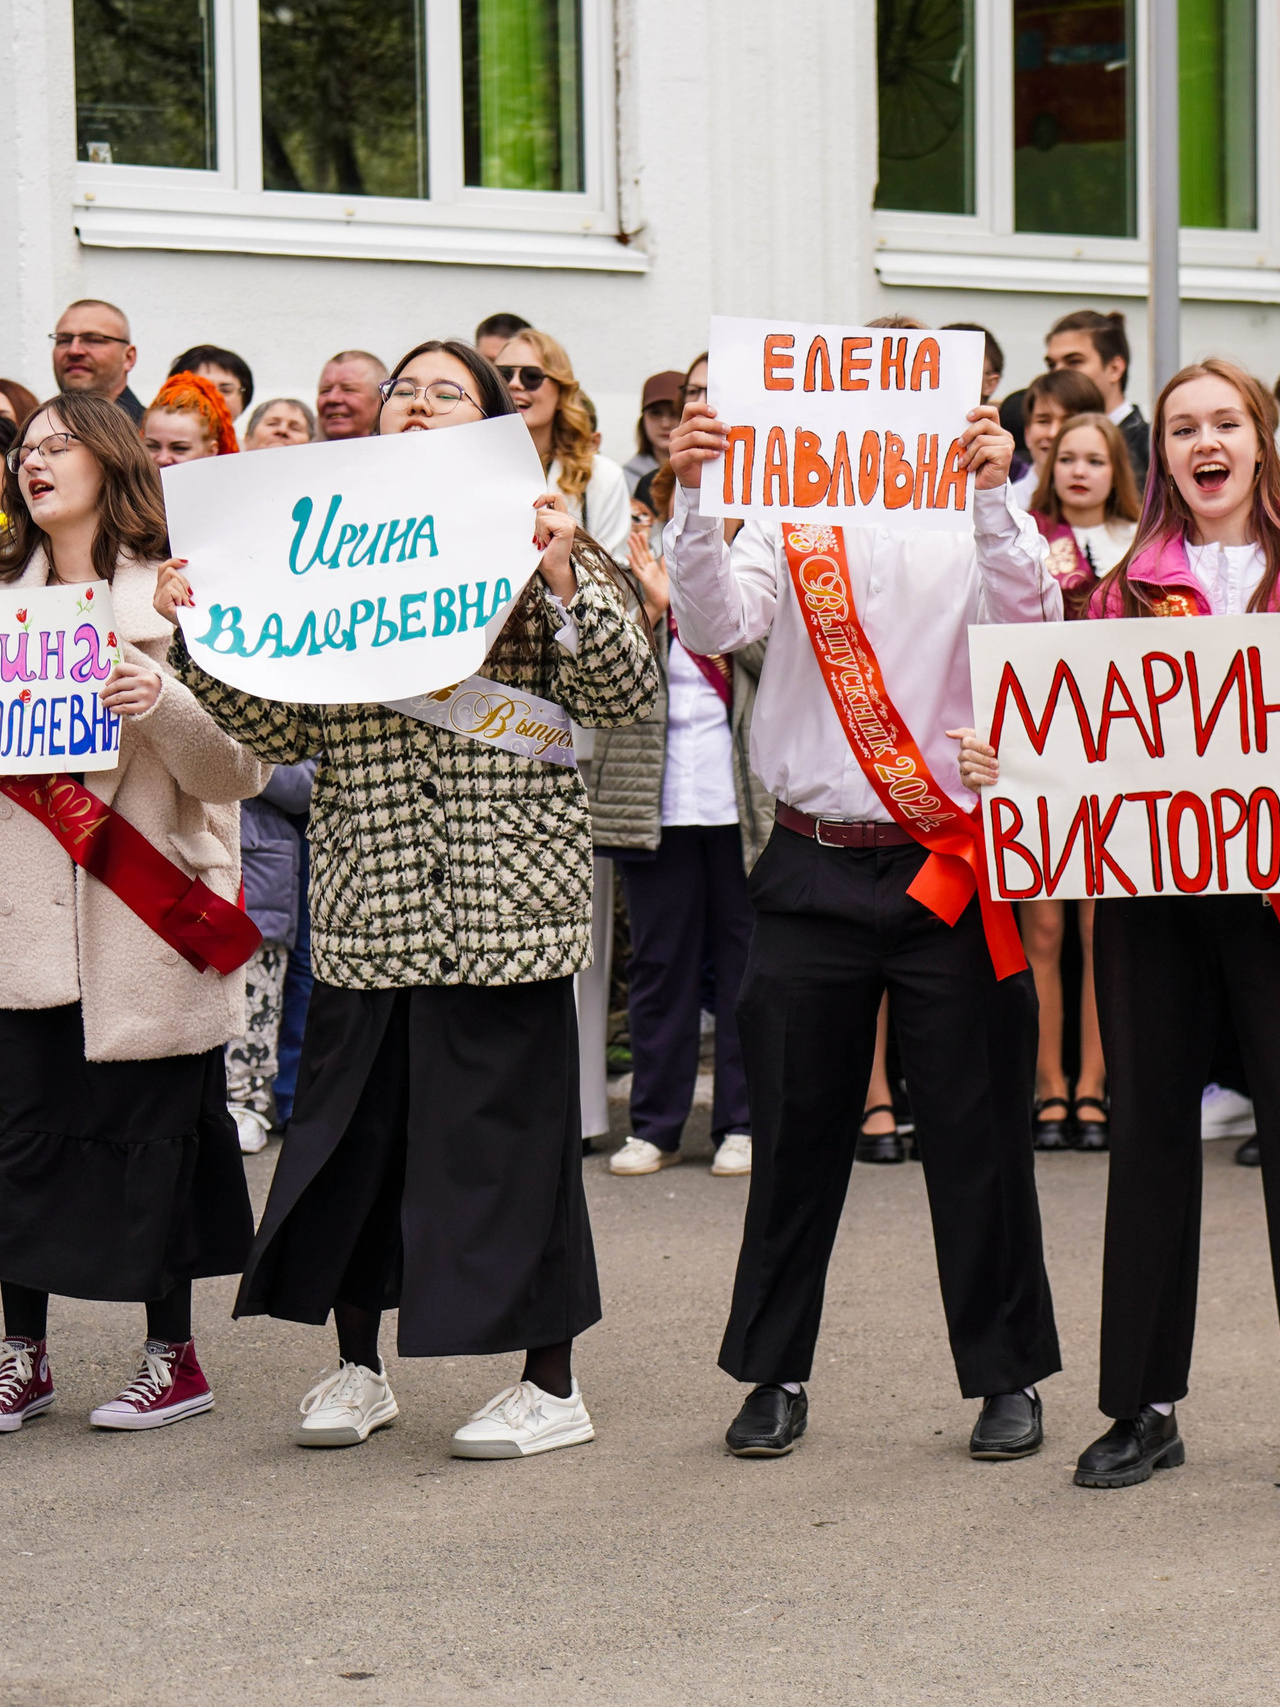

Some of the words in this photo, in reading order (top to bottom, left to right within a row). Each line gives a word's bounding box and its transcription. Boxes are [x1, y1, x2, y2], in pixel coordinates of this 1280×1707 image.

[763, 333, 941, 393] ЕЛЕНА
[723, 425, 969, 512] ПАВЛОВНА
[0, 691, 120, 758] ЛАЕВНА
[798, 554, 899, 759] Выпускник
[873, 755, 957, 833] 2024
